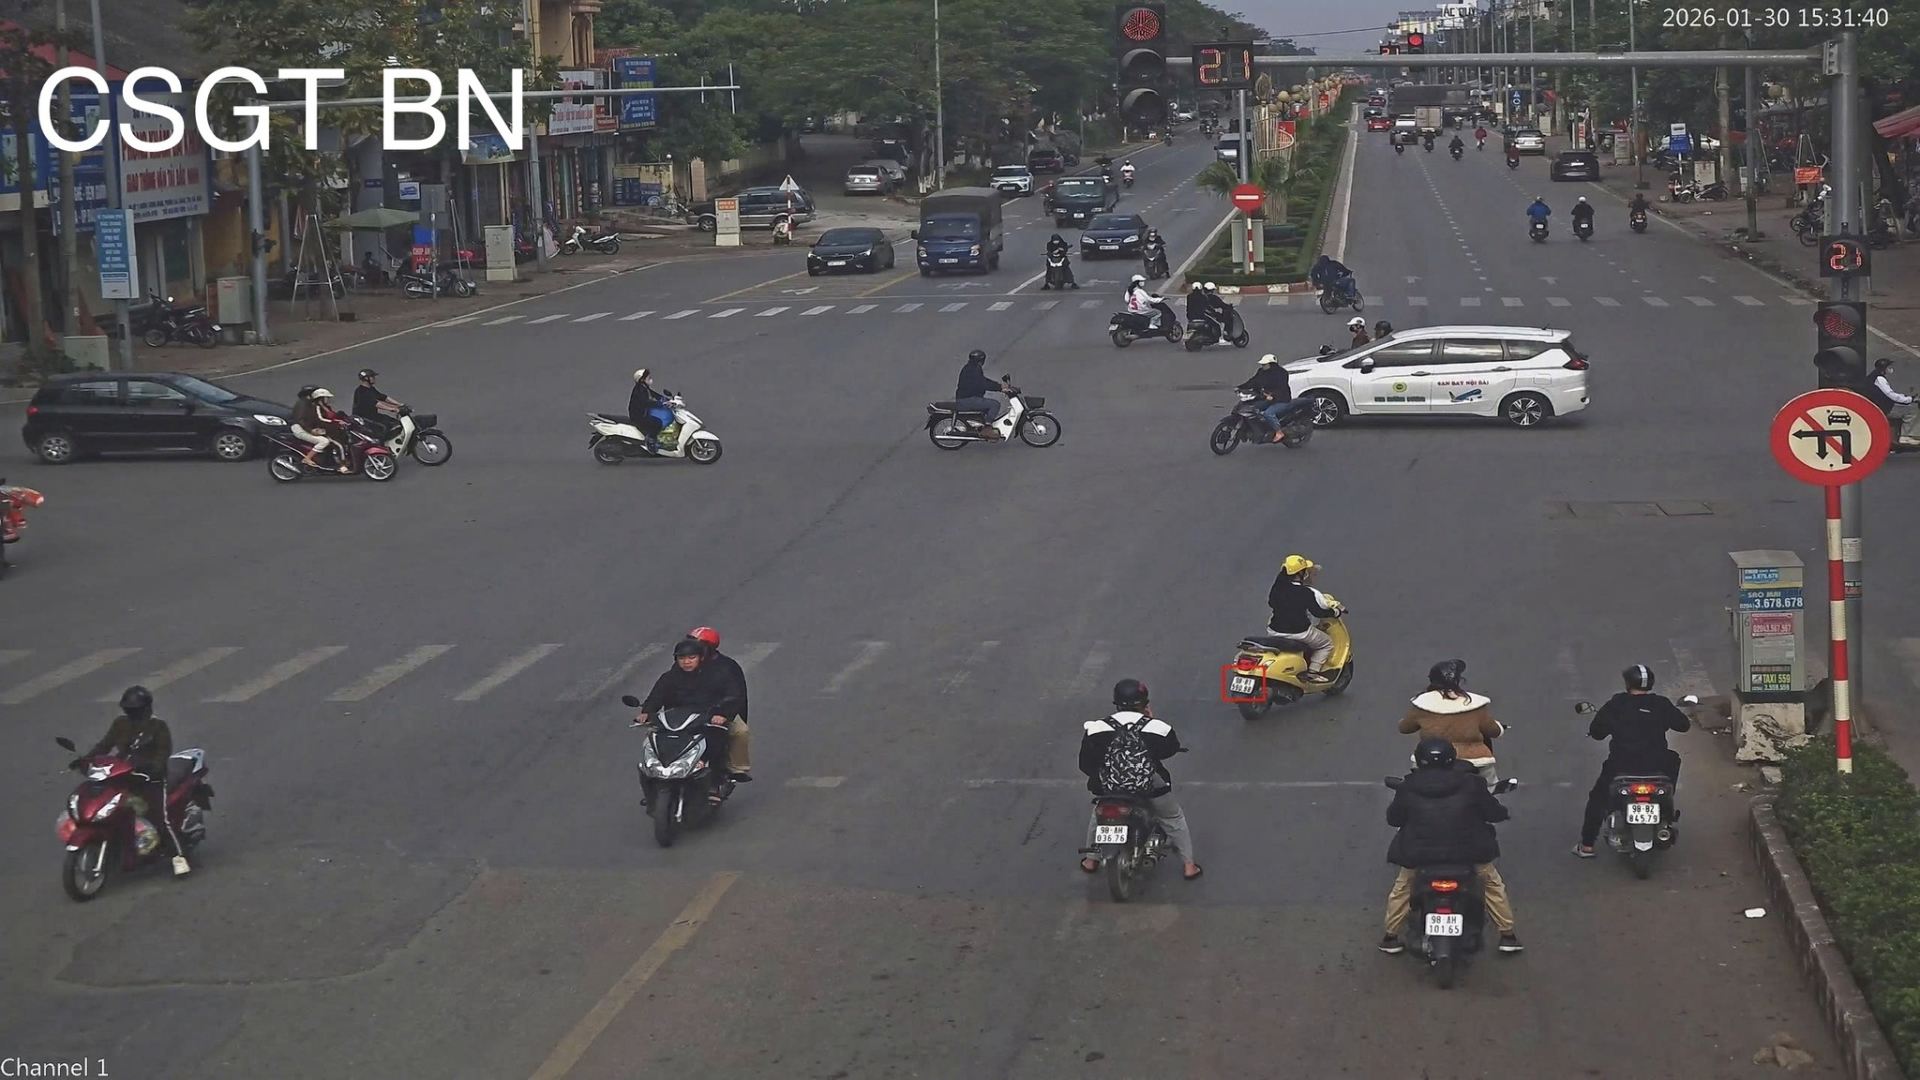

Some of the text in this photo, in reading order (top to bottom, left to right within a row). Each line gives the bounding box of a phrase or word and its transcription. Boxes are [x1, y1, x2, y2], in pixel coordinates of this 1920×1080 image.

[1199, 48, 1251, 84] 21
[1830, 243, 1862, 270] 21
[1754, 597, 1803, 609] 3.678.678
[1762, 673, 1791, 684] TAXI 559
